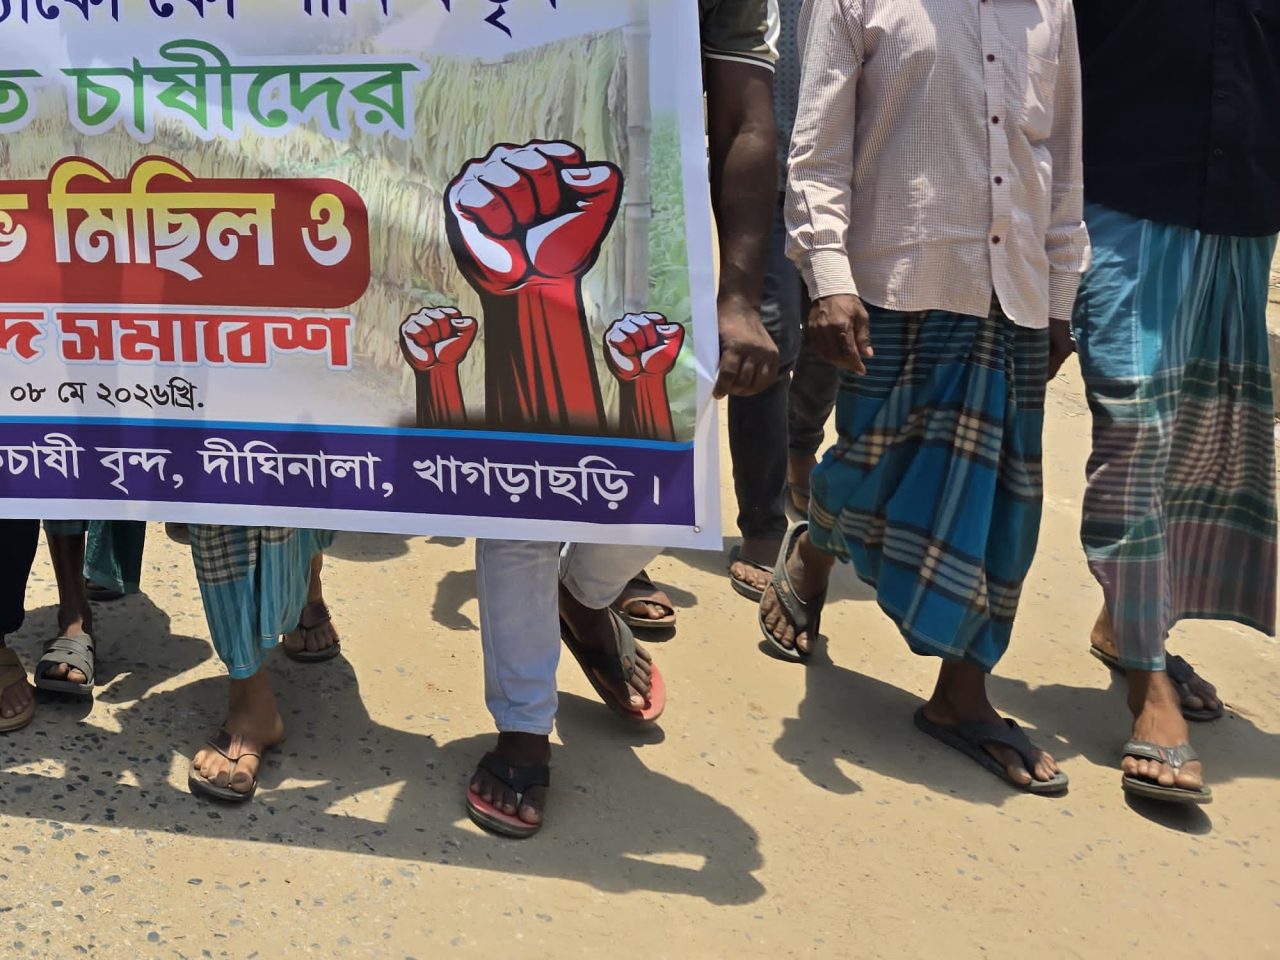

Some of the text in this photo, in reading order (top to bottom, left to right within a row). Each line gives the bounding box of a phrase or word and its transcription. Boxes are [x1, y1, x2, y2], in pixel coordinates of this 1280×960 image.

[61, 39, 420, 132] চাষীদের
[48, 160, 275, 281] মিছিল
[301, 193, 352, 266] ও
[56, 311, 351, 367] সমাবেশ
[10, 381, 47, 403] ০৮
[58, 380, 88, 406] মে
[95, 445, 185, 495] বৃন্দ,
[196, 437, 395, 498] দীঘিনালা,
